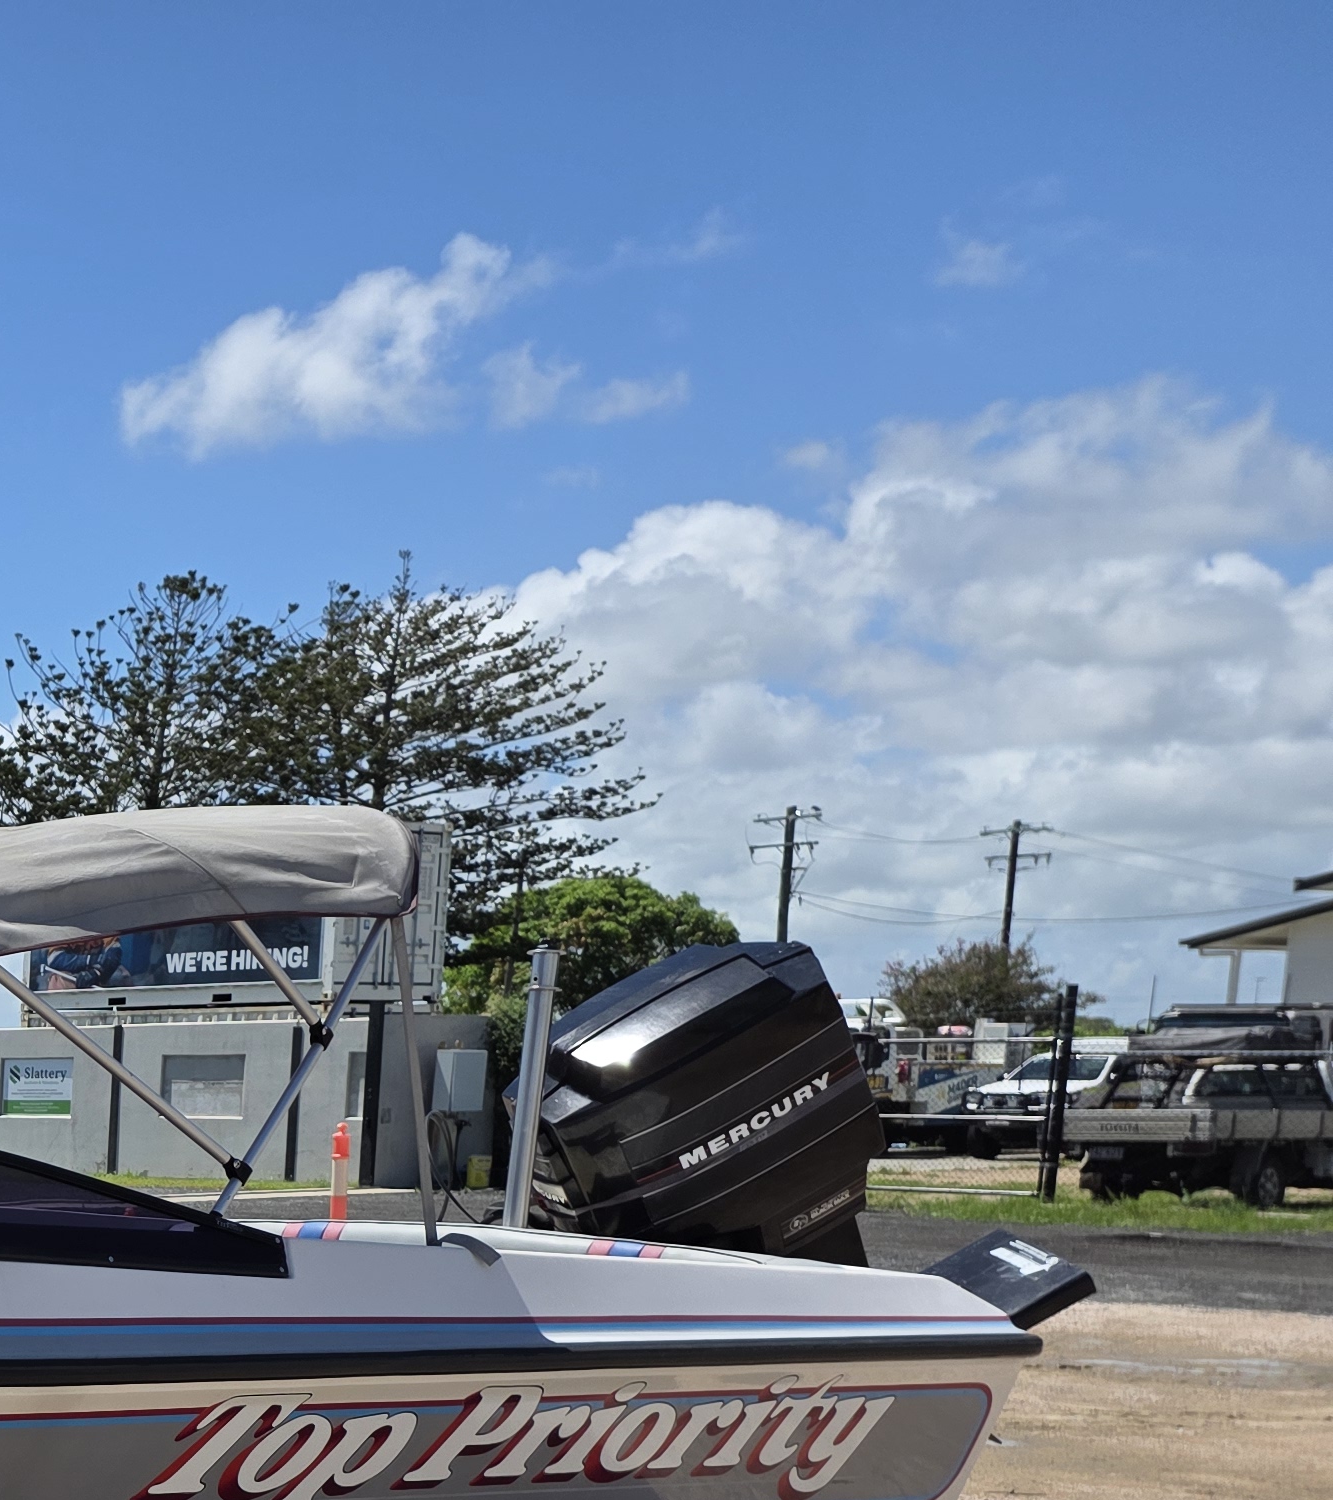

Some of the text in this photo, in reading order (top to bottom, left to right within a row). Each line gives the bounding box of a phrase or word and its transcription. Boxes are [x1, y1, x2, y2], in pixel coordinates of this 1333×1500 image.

[166, 950, 228, 973] WE'RE
[24, 1066, 68, 1083] Slattery
[678, 1071, 830, 1170] MERCURY
